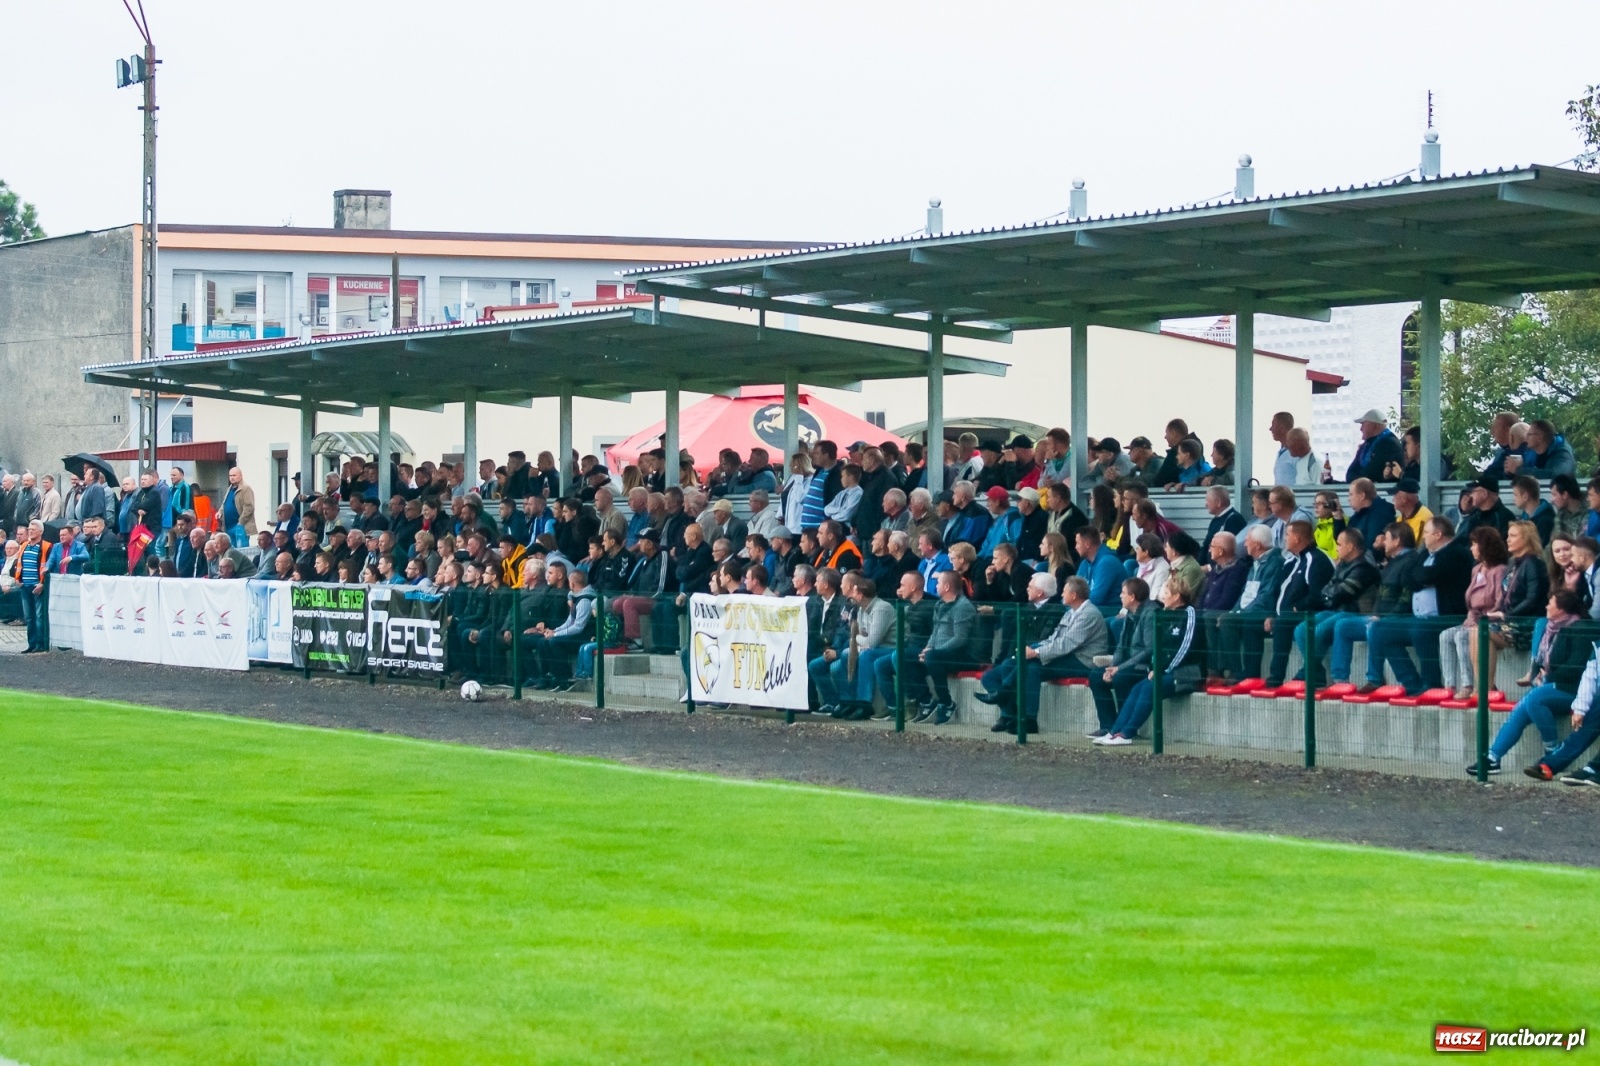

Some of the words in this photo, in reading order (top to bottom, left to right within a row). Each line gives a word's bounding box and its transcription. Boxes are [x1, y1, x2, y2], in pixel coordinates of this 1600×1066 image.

[343, 280, 384, 290] KUCHENNE
[208, 329, 237, 339] MEBLE
[239, 330, 251, 339] NA
[367, 656, 444, 672] SPORTSWEAR
[763, 641, 793, 693] club
